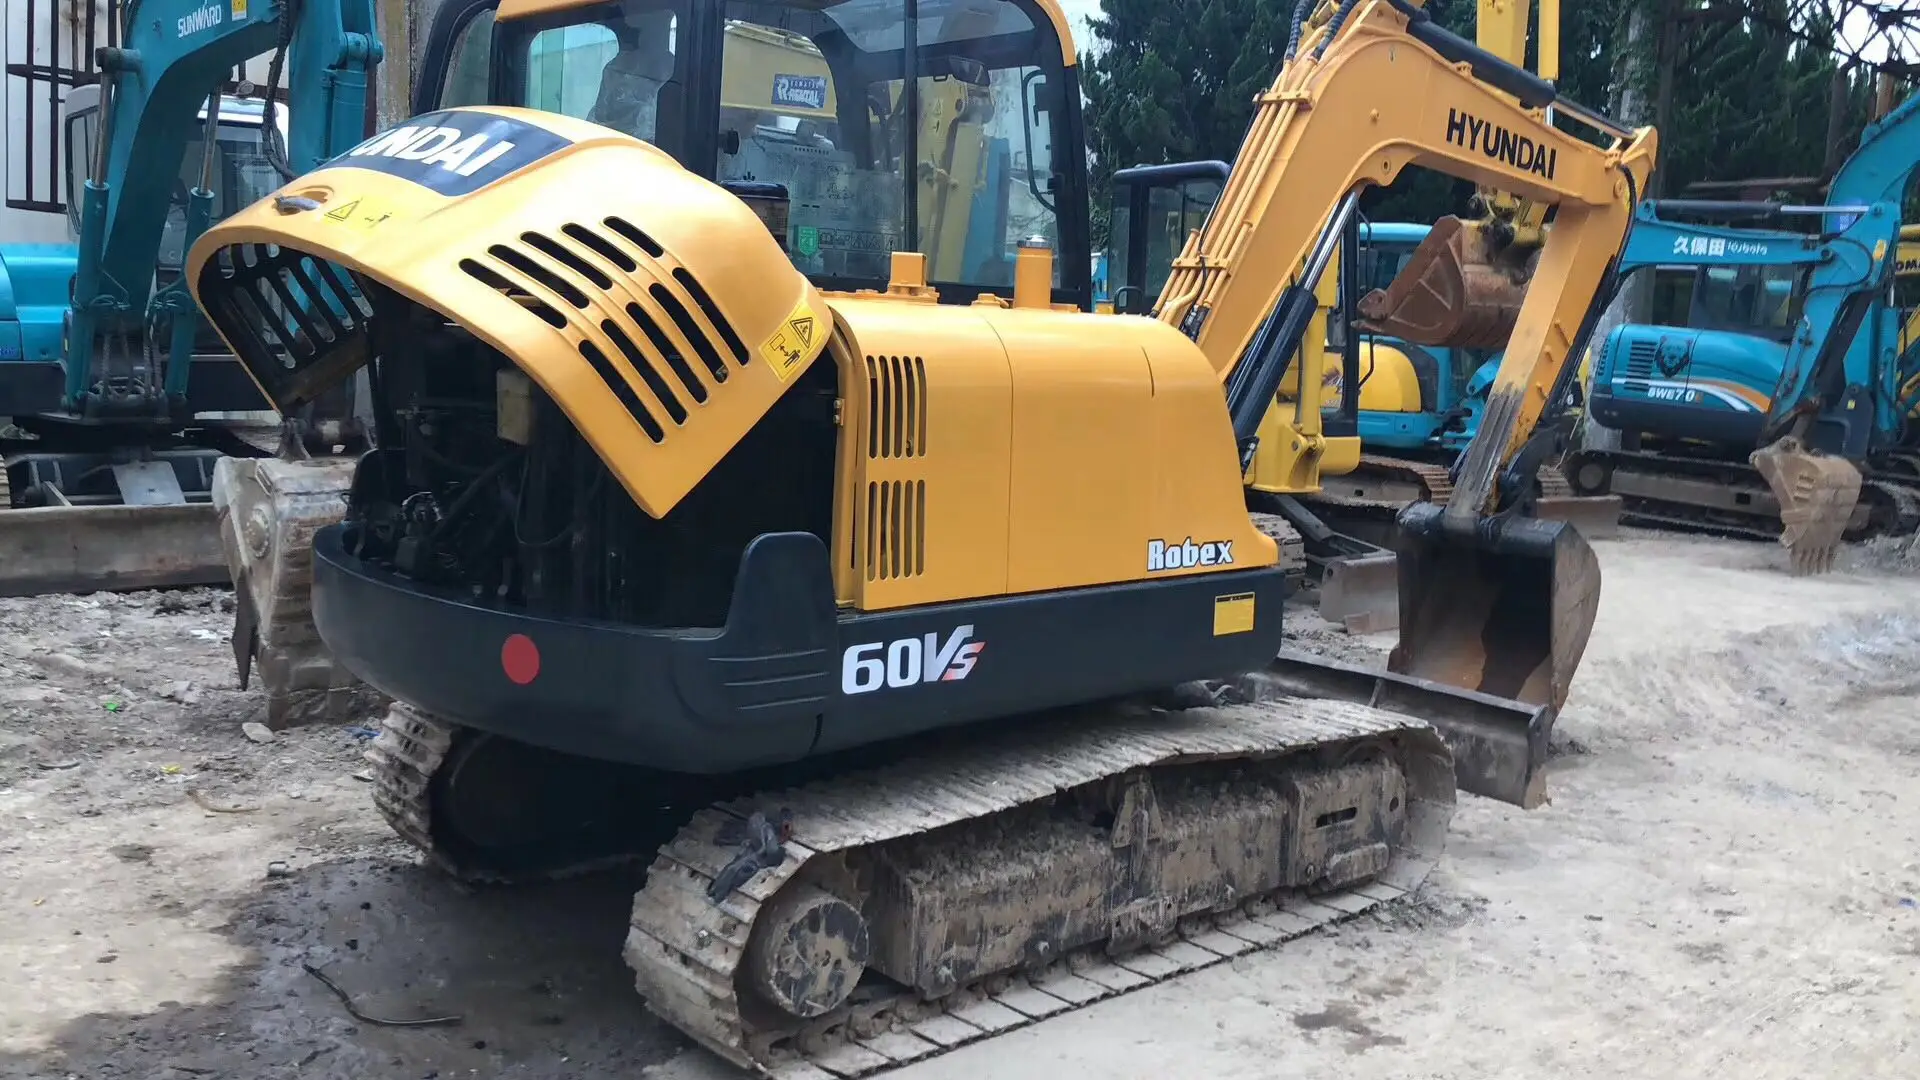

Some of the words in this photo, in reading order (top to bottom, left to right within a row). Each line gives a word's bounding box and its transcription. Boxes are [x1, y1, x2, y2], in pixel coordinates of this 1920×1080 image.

[178, 4, 222, 38] SUNWARD
[1446, 107, 1557, 180] HYUNDAI
[1673, 235, 1727, 257] 久保田
[1147, 536, 1233, 571] Robex
